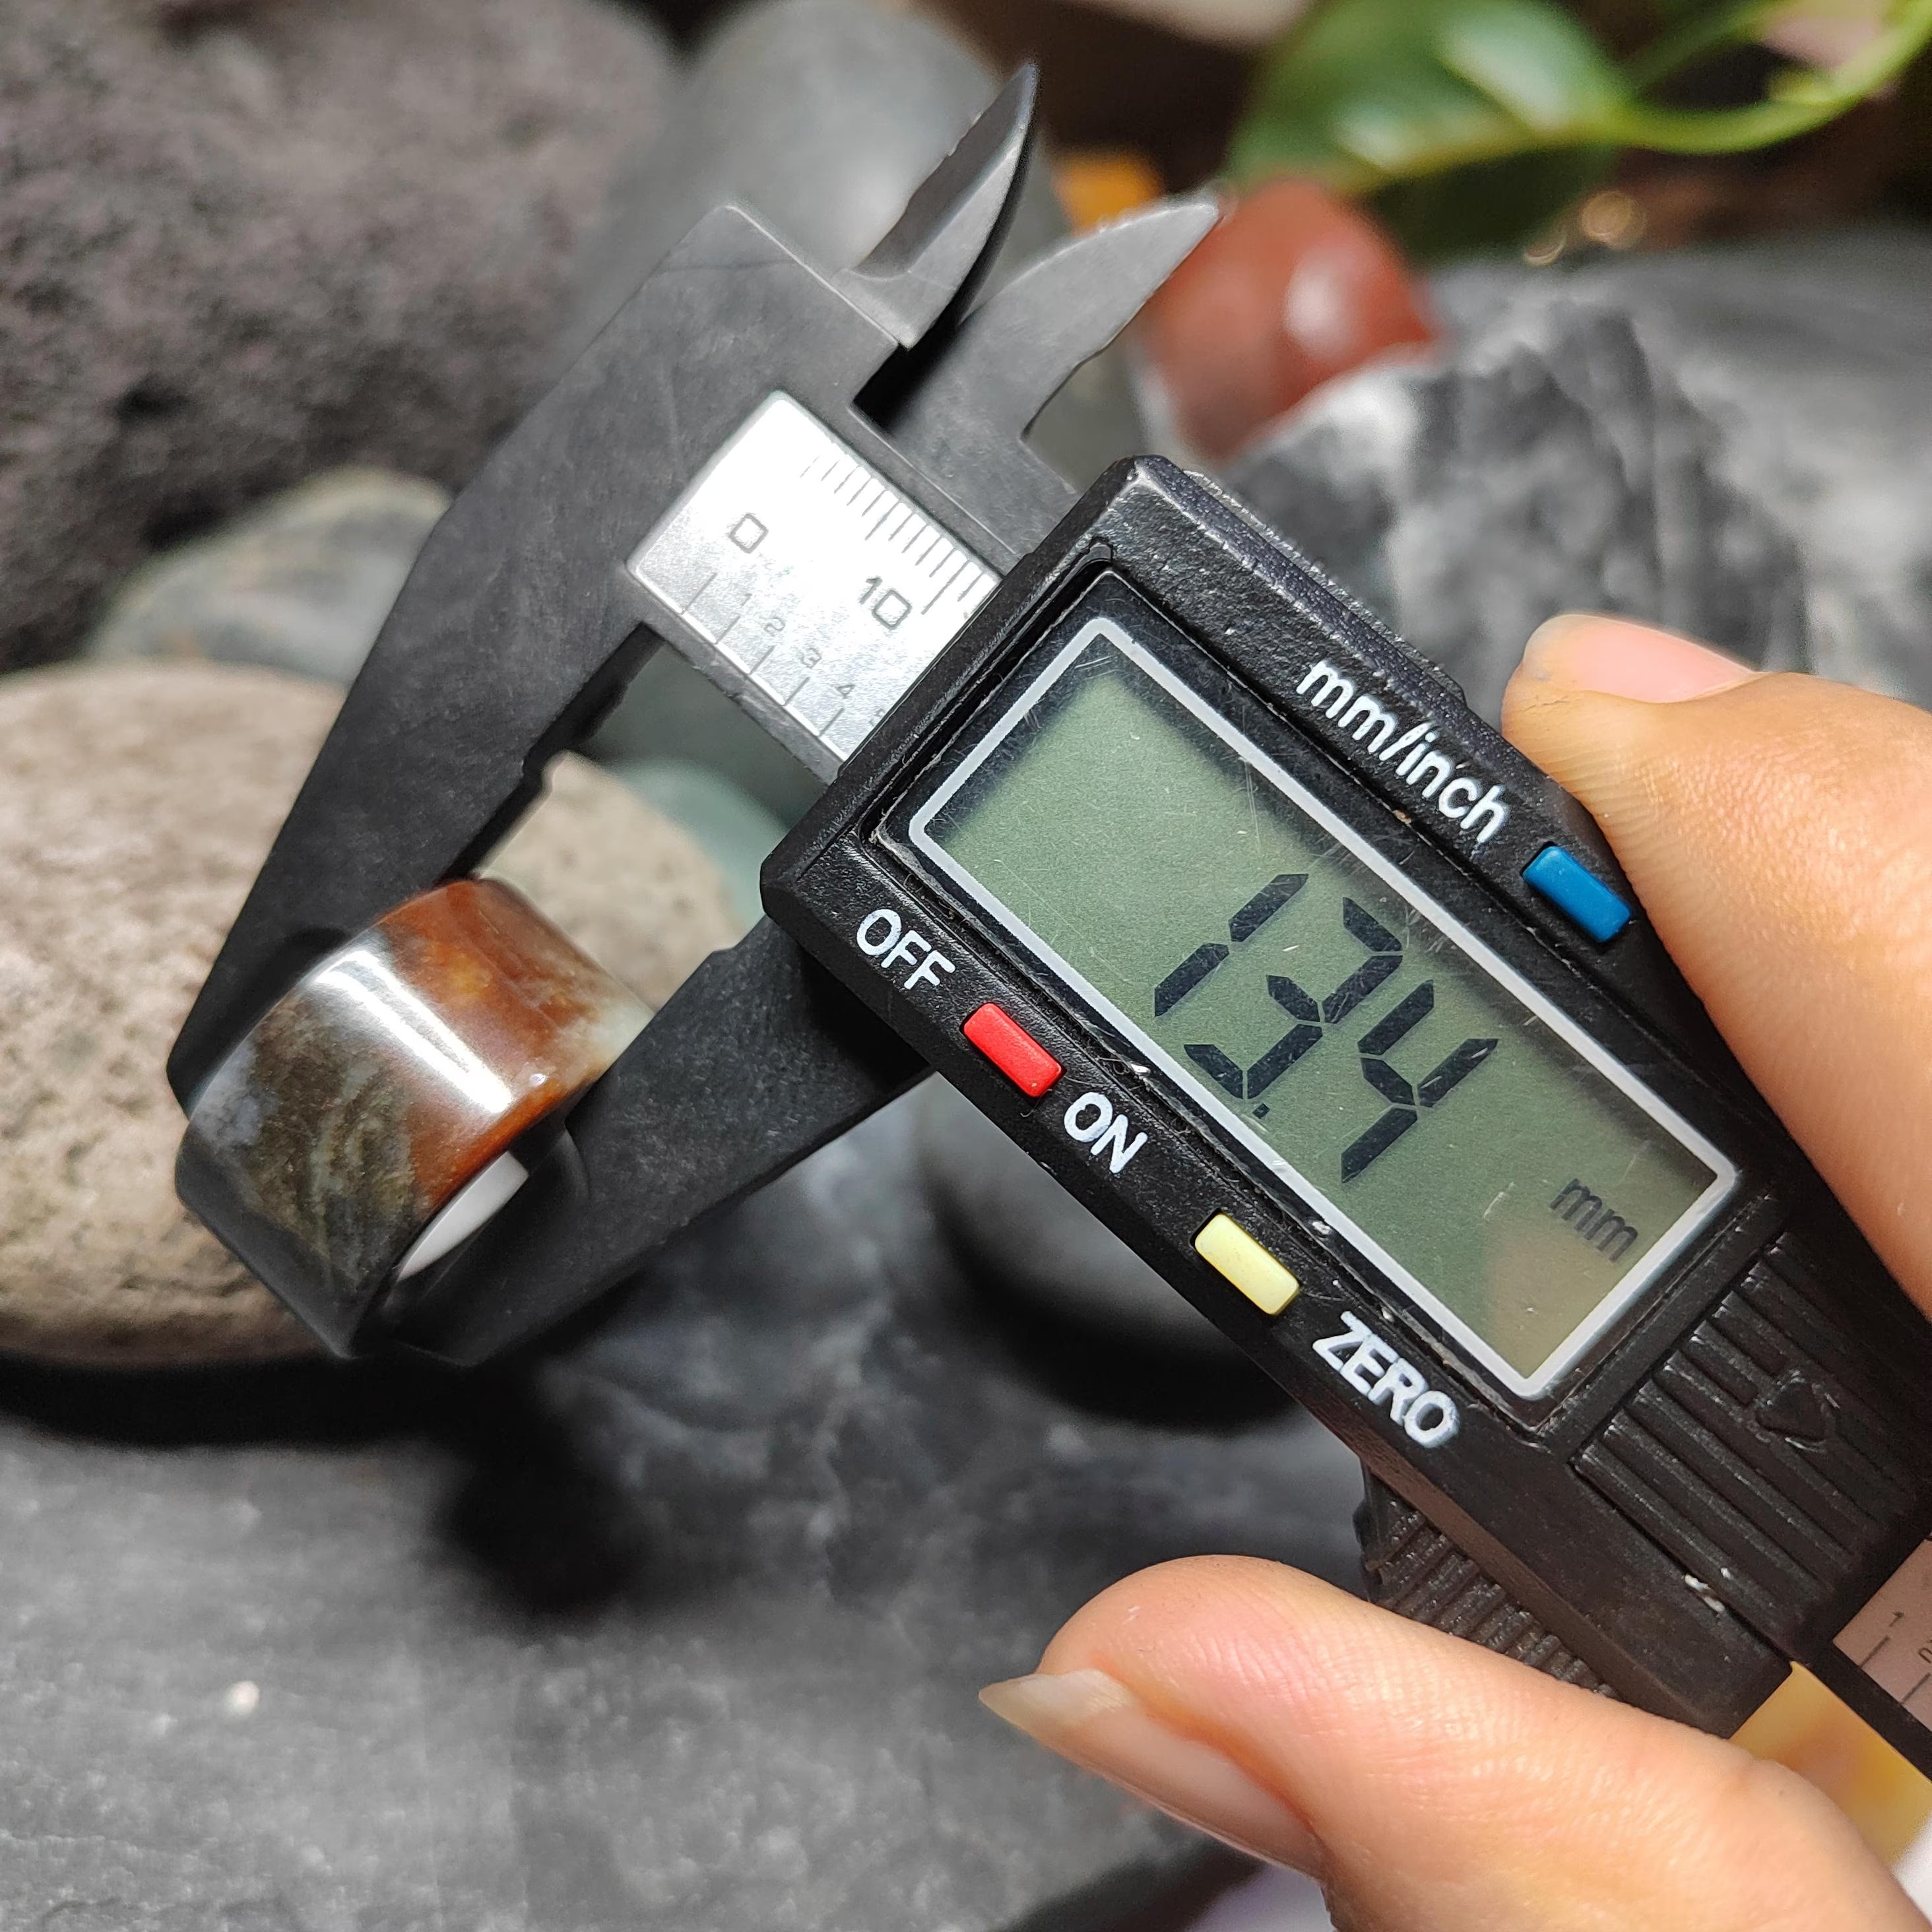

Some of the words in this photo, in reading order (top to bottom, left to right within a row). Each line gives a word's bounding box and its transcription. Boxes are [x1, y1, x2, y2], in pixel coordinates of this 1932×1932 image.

[728, 513, 768, 554] 0
[858, 575, 913, 631] 10
[763, 616, 786, 637] 2
[798, 647, 823, 669] 3
[834, 683, 856, 699] 4
[1295, 660, 1510, 845] mm/inch
[856, 909, 957, 990] OFF
[1153, 873, 1500, 1184] 13.4
[1063, 1091, 1149, 1175] ON
[1549, 1177, 1639, 1263] mm
[1312, 1310, 1461, 1449] ZERO
